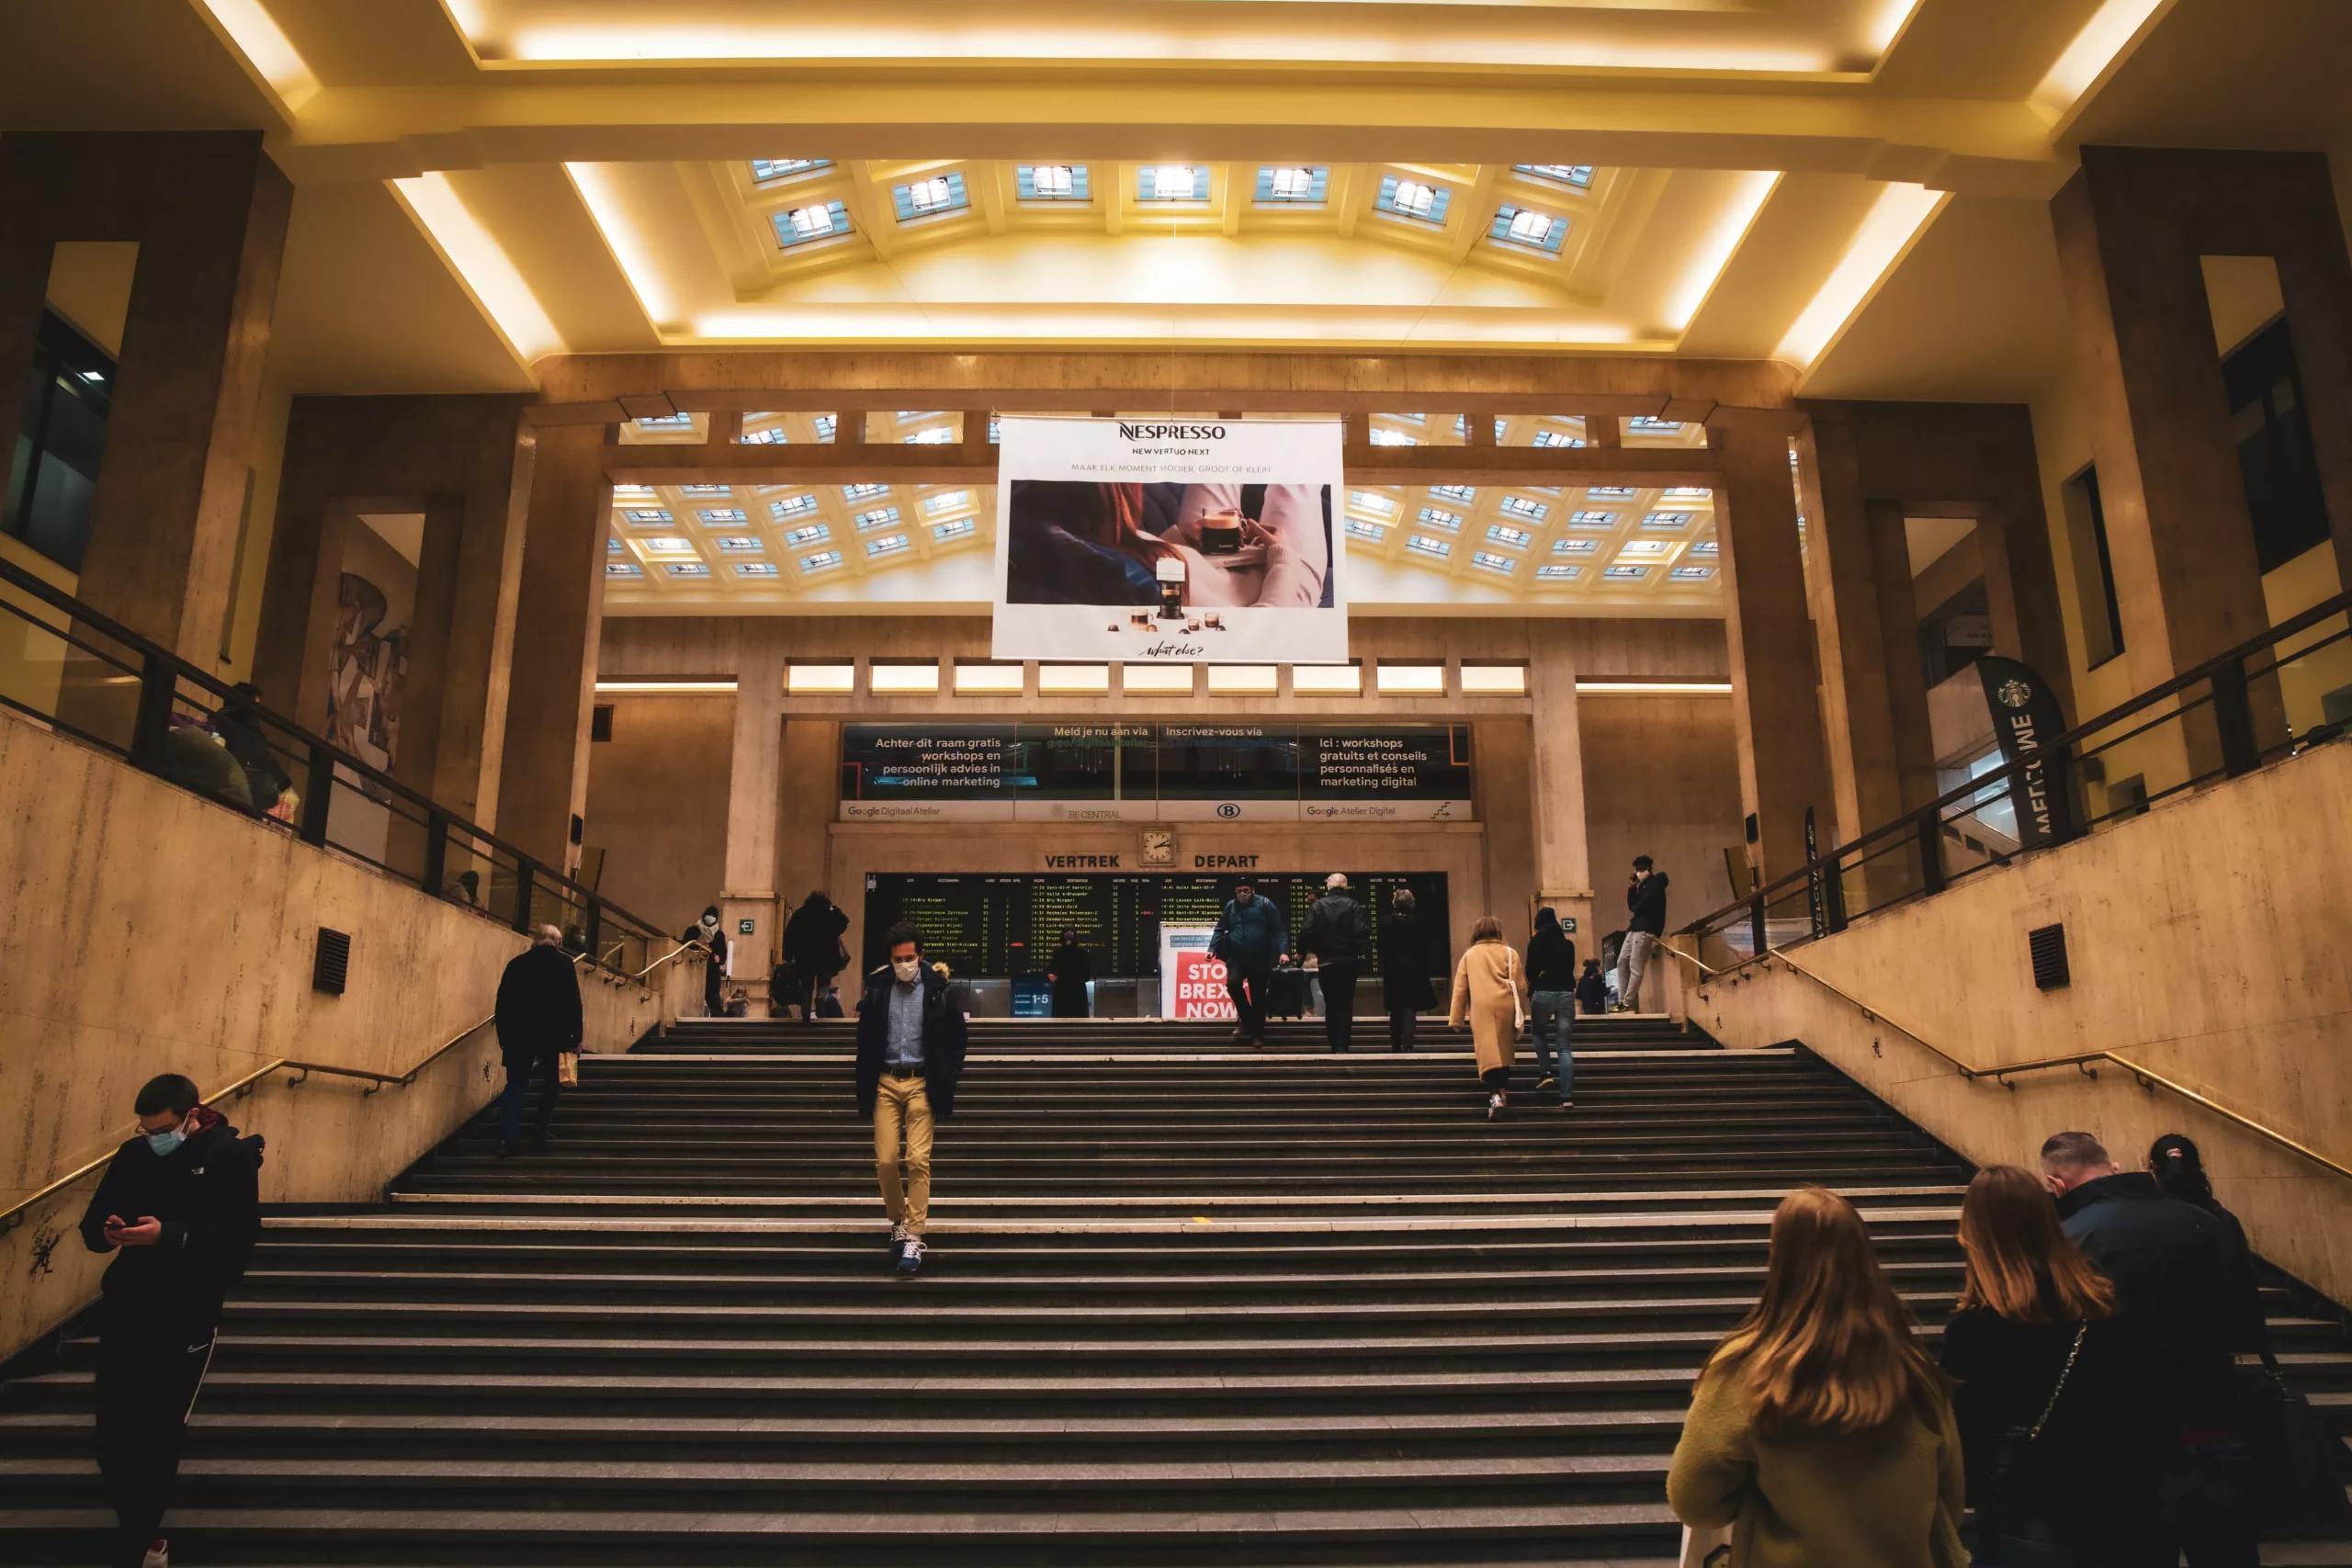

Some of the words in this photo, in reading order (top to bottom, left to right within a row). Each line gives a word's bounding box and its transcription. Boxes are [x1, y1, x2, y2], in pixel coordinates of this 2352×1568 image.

[1120, 422, 1226, 442] NESPRESSO
[1159, 465, 1196, 473] MOOIER,
[1138, 640, 1177, 657] what
[1175, 643, 1204, 656] else?
[1054, 728, 1080, 737] Meld
[1082, 728, 1092, 739] je
[1132, 728, 1148, 737] via
[1166, 728, 1244, 737] Inscrivez-vous
[1246, 728, 1262, 737] via
[876, 739, 914, 748] Achter
[916, 739, 933, 748] dit
[936, 739, 966, 748] raam
[967, 738, 1001, 750] gratis
[1319, 739, 1333, 748] Ici
[1341, 739, 1404, 750] workshops
[922, 751, 984, 762] workshops
[986, 752, 1001, 761] en
[1319, 751, 1364, 762] gratuits
[1367, 752, 1379, 761] et
[1381, 751, 1428, 761] conseils
[883, 764, 948, 775] persoonlijk
[950, 764, 988, 773] advies
[989, 763, 1001, 773] in
[1320, 764, 1398, 775] personnalisés
[902, 777, 939, 786] online
[942, 777, 1001, 788] marketing
[1320, 777, 1379, 788] marketing
[1381, 777, 1417, 788] digital
[848, 807, 880, 817] Google
[881, 807, 912, 817] Digitaal
[913, 807, 940, 815] Atelier
[1069, 810, 1080, 818] BE
[1080, 810, 1122, 818] CENTRAL
[1306, 807, 1339, 817] Google
[1340, 807, 1367, 815] Atelier
[1369, 807, 1396, 817] Digital
[1045, 855, 1121, 868] VERTREK
[1194, 855, 1260, 868] DEPART
[1188, 964, 1227, 980] STO
[1180, 983, 1231, 999] BREX
[1032, 994, 1049, 1004] 1-5
[1186, 1002, 1239, 1019] NOW
